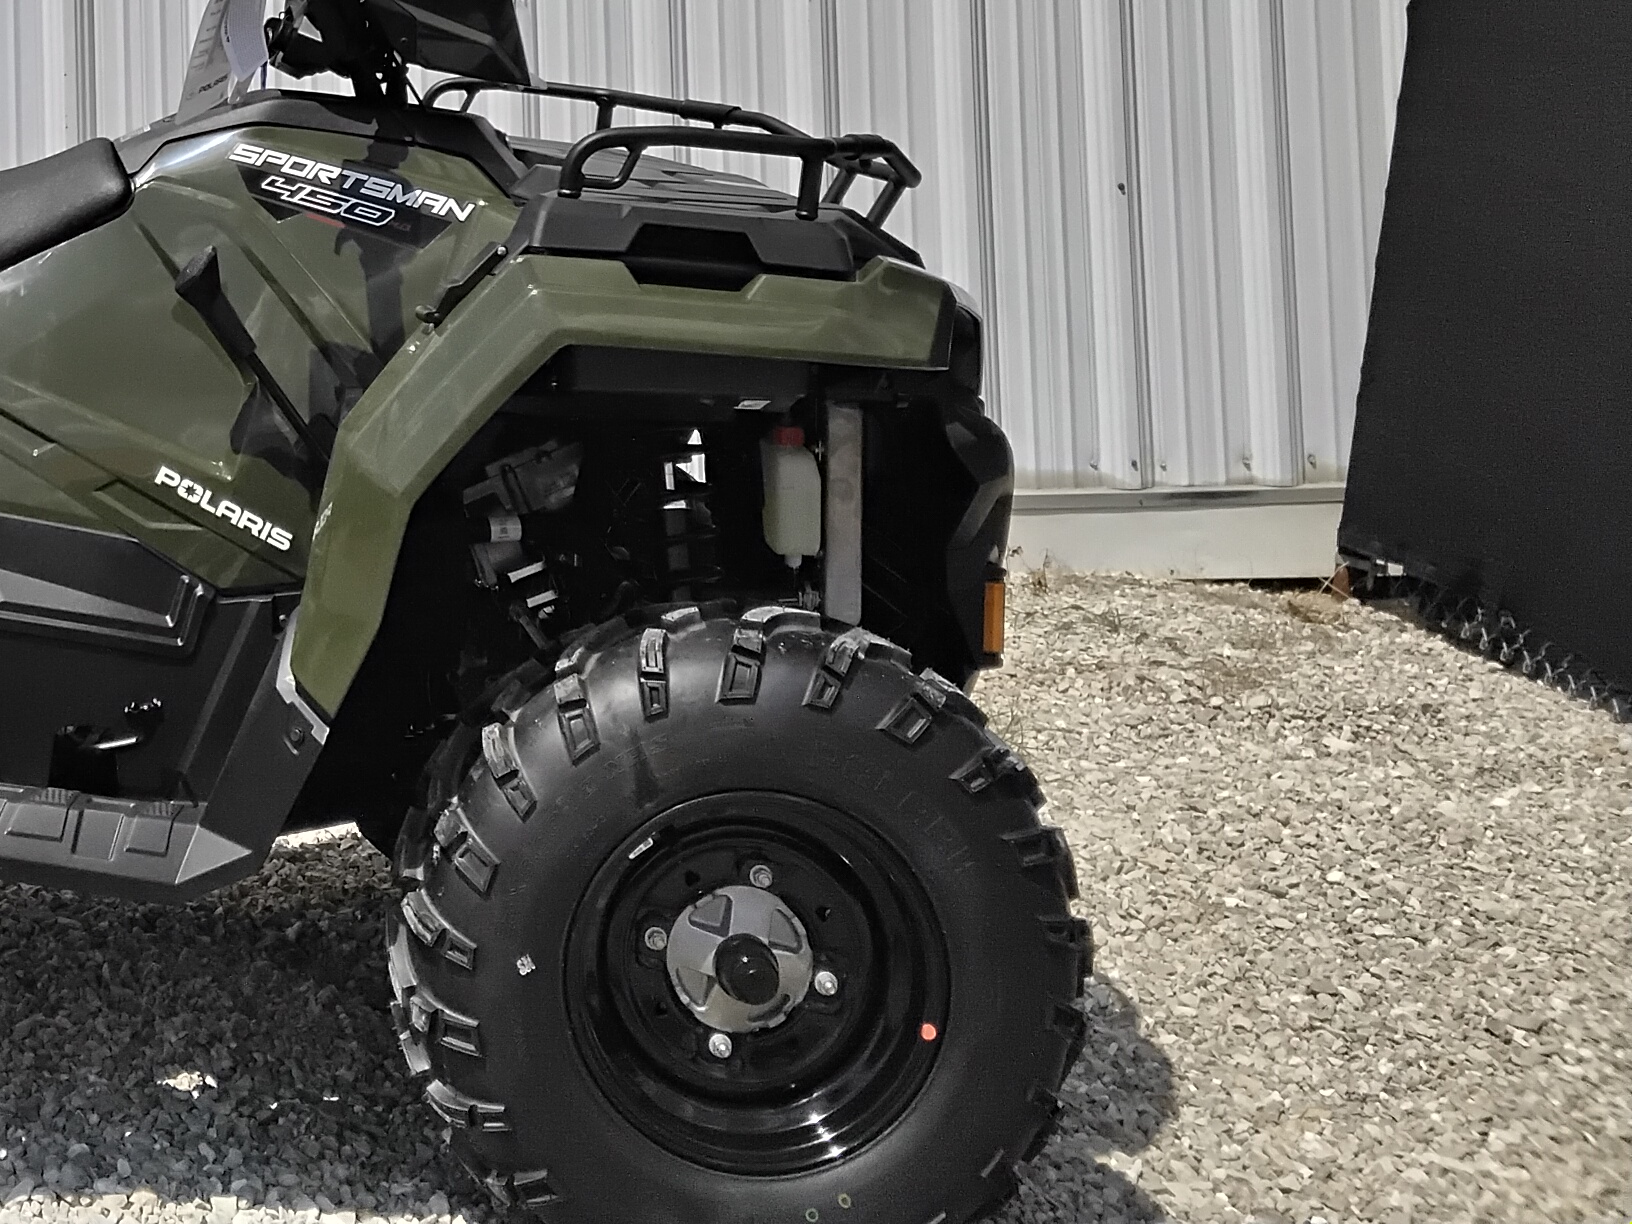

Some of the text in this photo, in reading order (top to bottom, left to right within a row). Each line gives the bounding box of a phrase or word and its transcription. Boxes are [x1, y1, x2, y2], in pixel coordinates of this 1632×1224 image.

[228, 143, 476, 222] SPORTSMAN
[261, 176, 395, 226] 450
[154, 465, 294, 552] POLARIS
